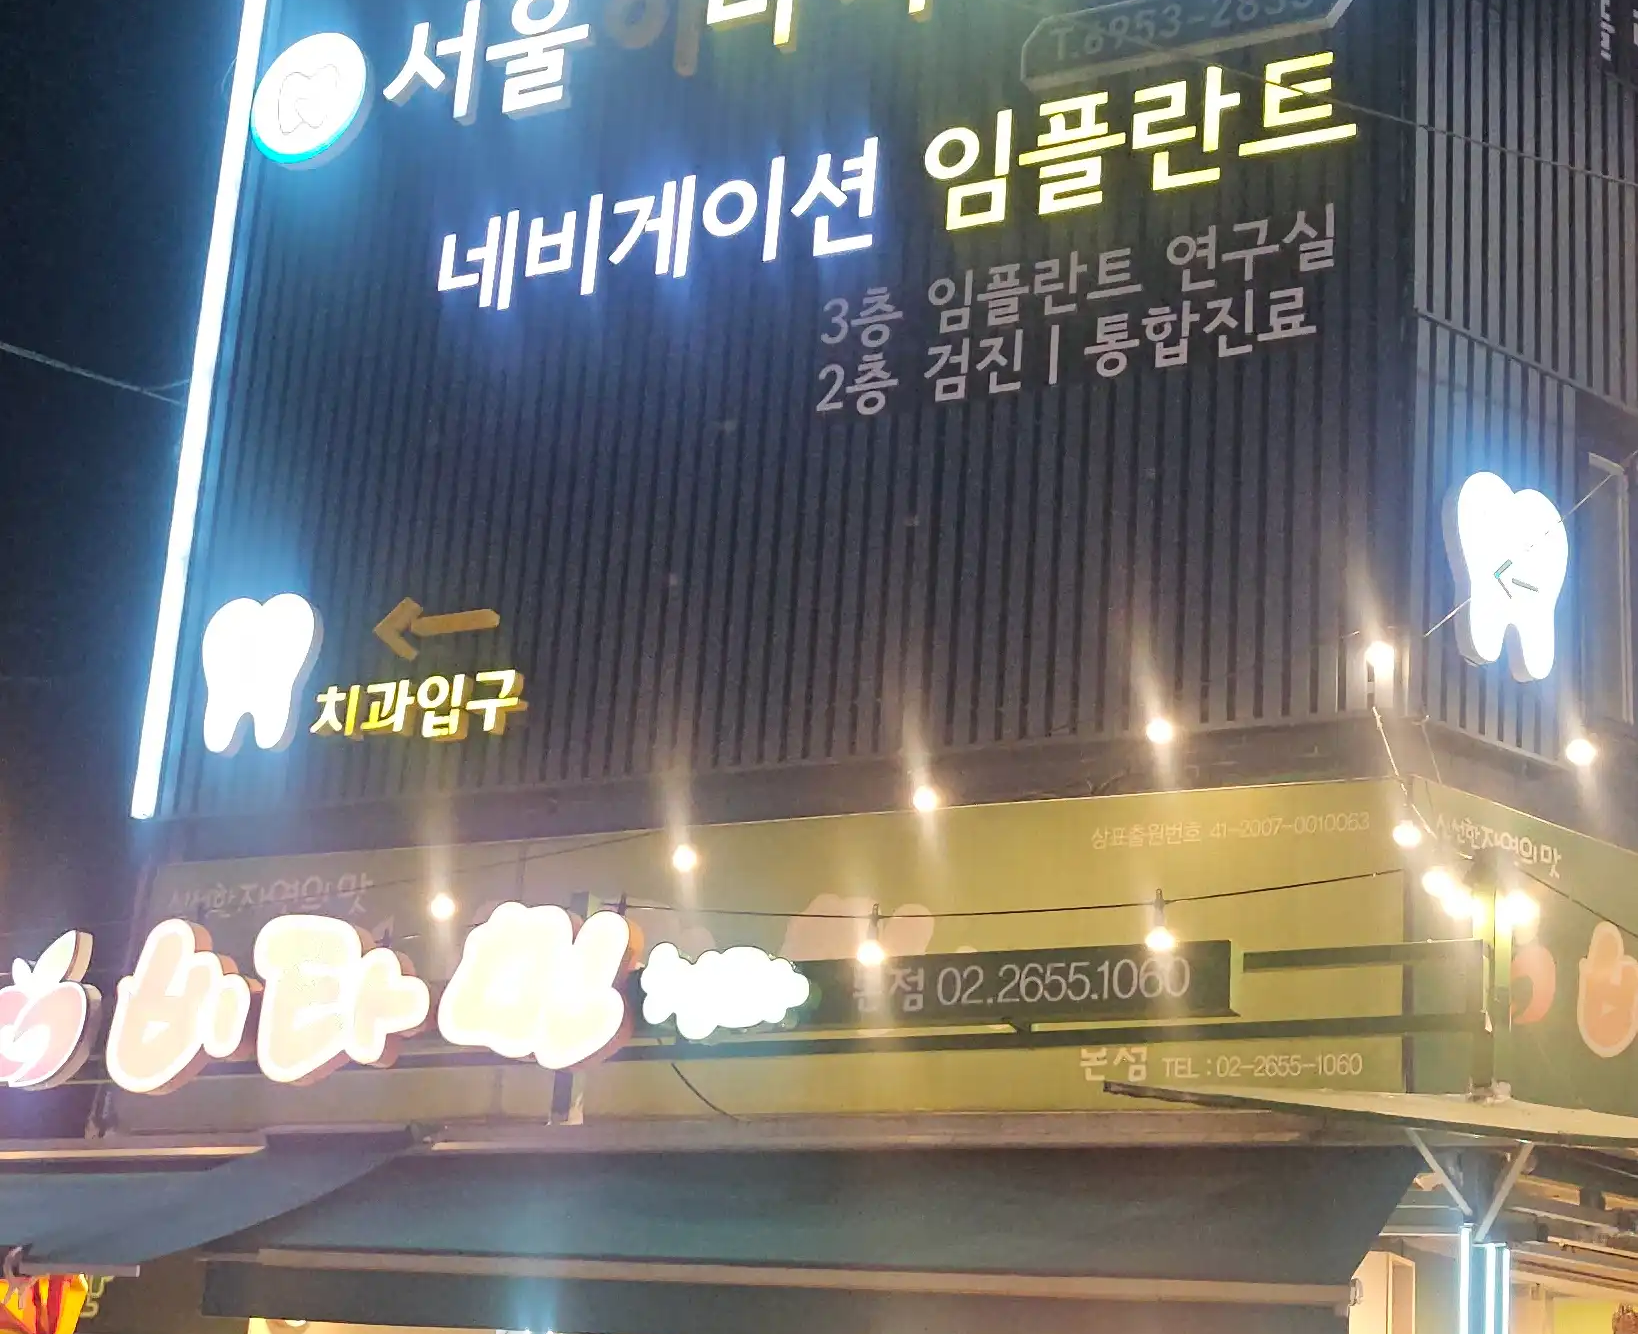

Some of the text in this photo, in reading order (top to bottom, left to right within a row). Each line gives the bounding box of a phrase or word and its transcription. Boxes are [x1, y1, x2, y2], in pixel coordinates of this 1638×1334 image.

[436, 52, 1358, 311] 네비게이션 임플란트
[820, 203, 1336, 349] 3층 임플란트 연구실
[816, 353, 899, 416] 2층
[924, 329, 1022, 402] 검진
[1084, 286, 1317, 378] 통합진료
[309, 669, 526, 742] 치과입구
[1090, 821, 1202, 850] 상표출원번호
[936, 956, 1191, 1006] 02.2655.1060
[1215, 1052, 1364, 1079] 02-2655-1060
